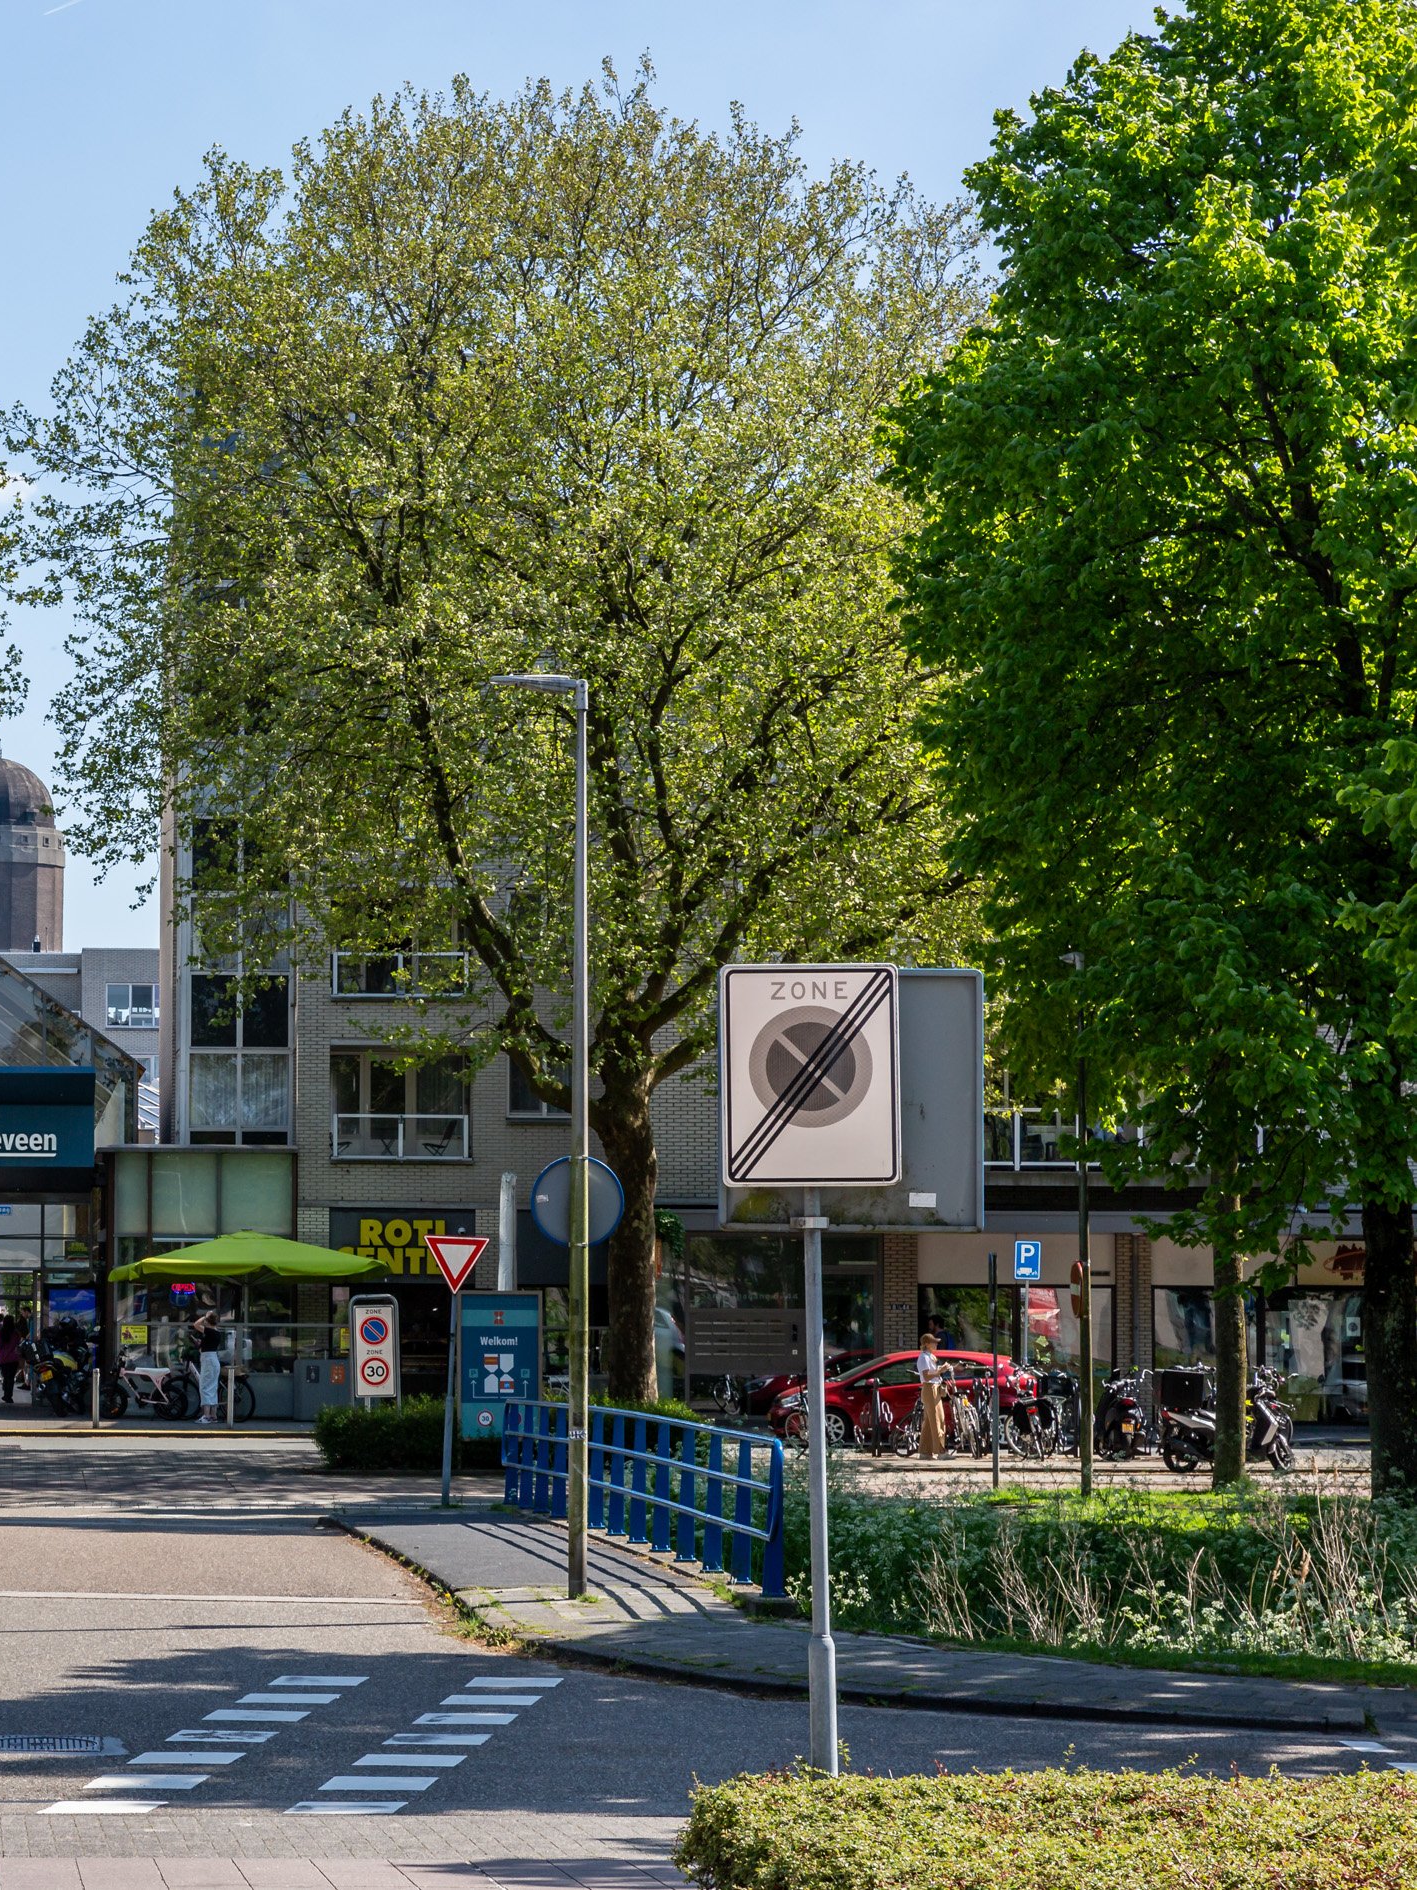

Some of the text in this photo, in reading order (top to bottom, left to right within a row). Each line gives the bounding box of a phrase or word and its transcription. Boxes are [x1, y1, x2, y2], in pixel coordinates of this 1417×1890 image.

[771, 981, 848, 1000] ZONE
[360, 1219, 445, 1247] ROTI
[1020, 1244, 1035, 1264] P
[480, 1336, 518, 1346] Welkom!
[366, 1366, 385, 1377] 30
